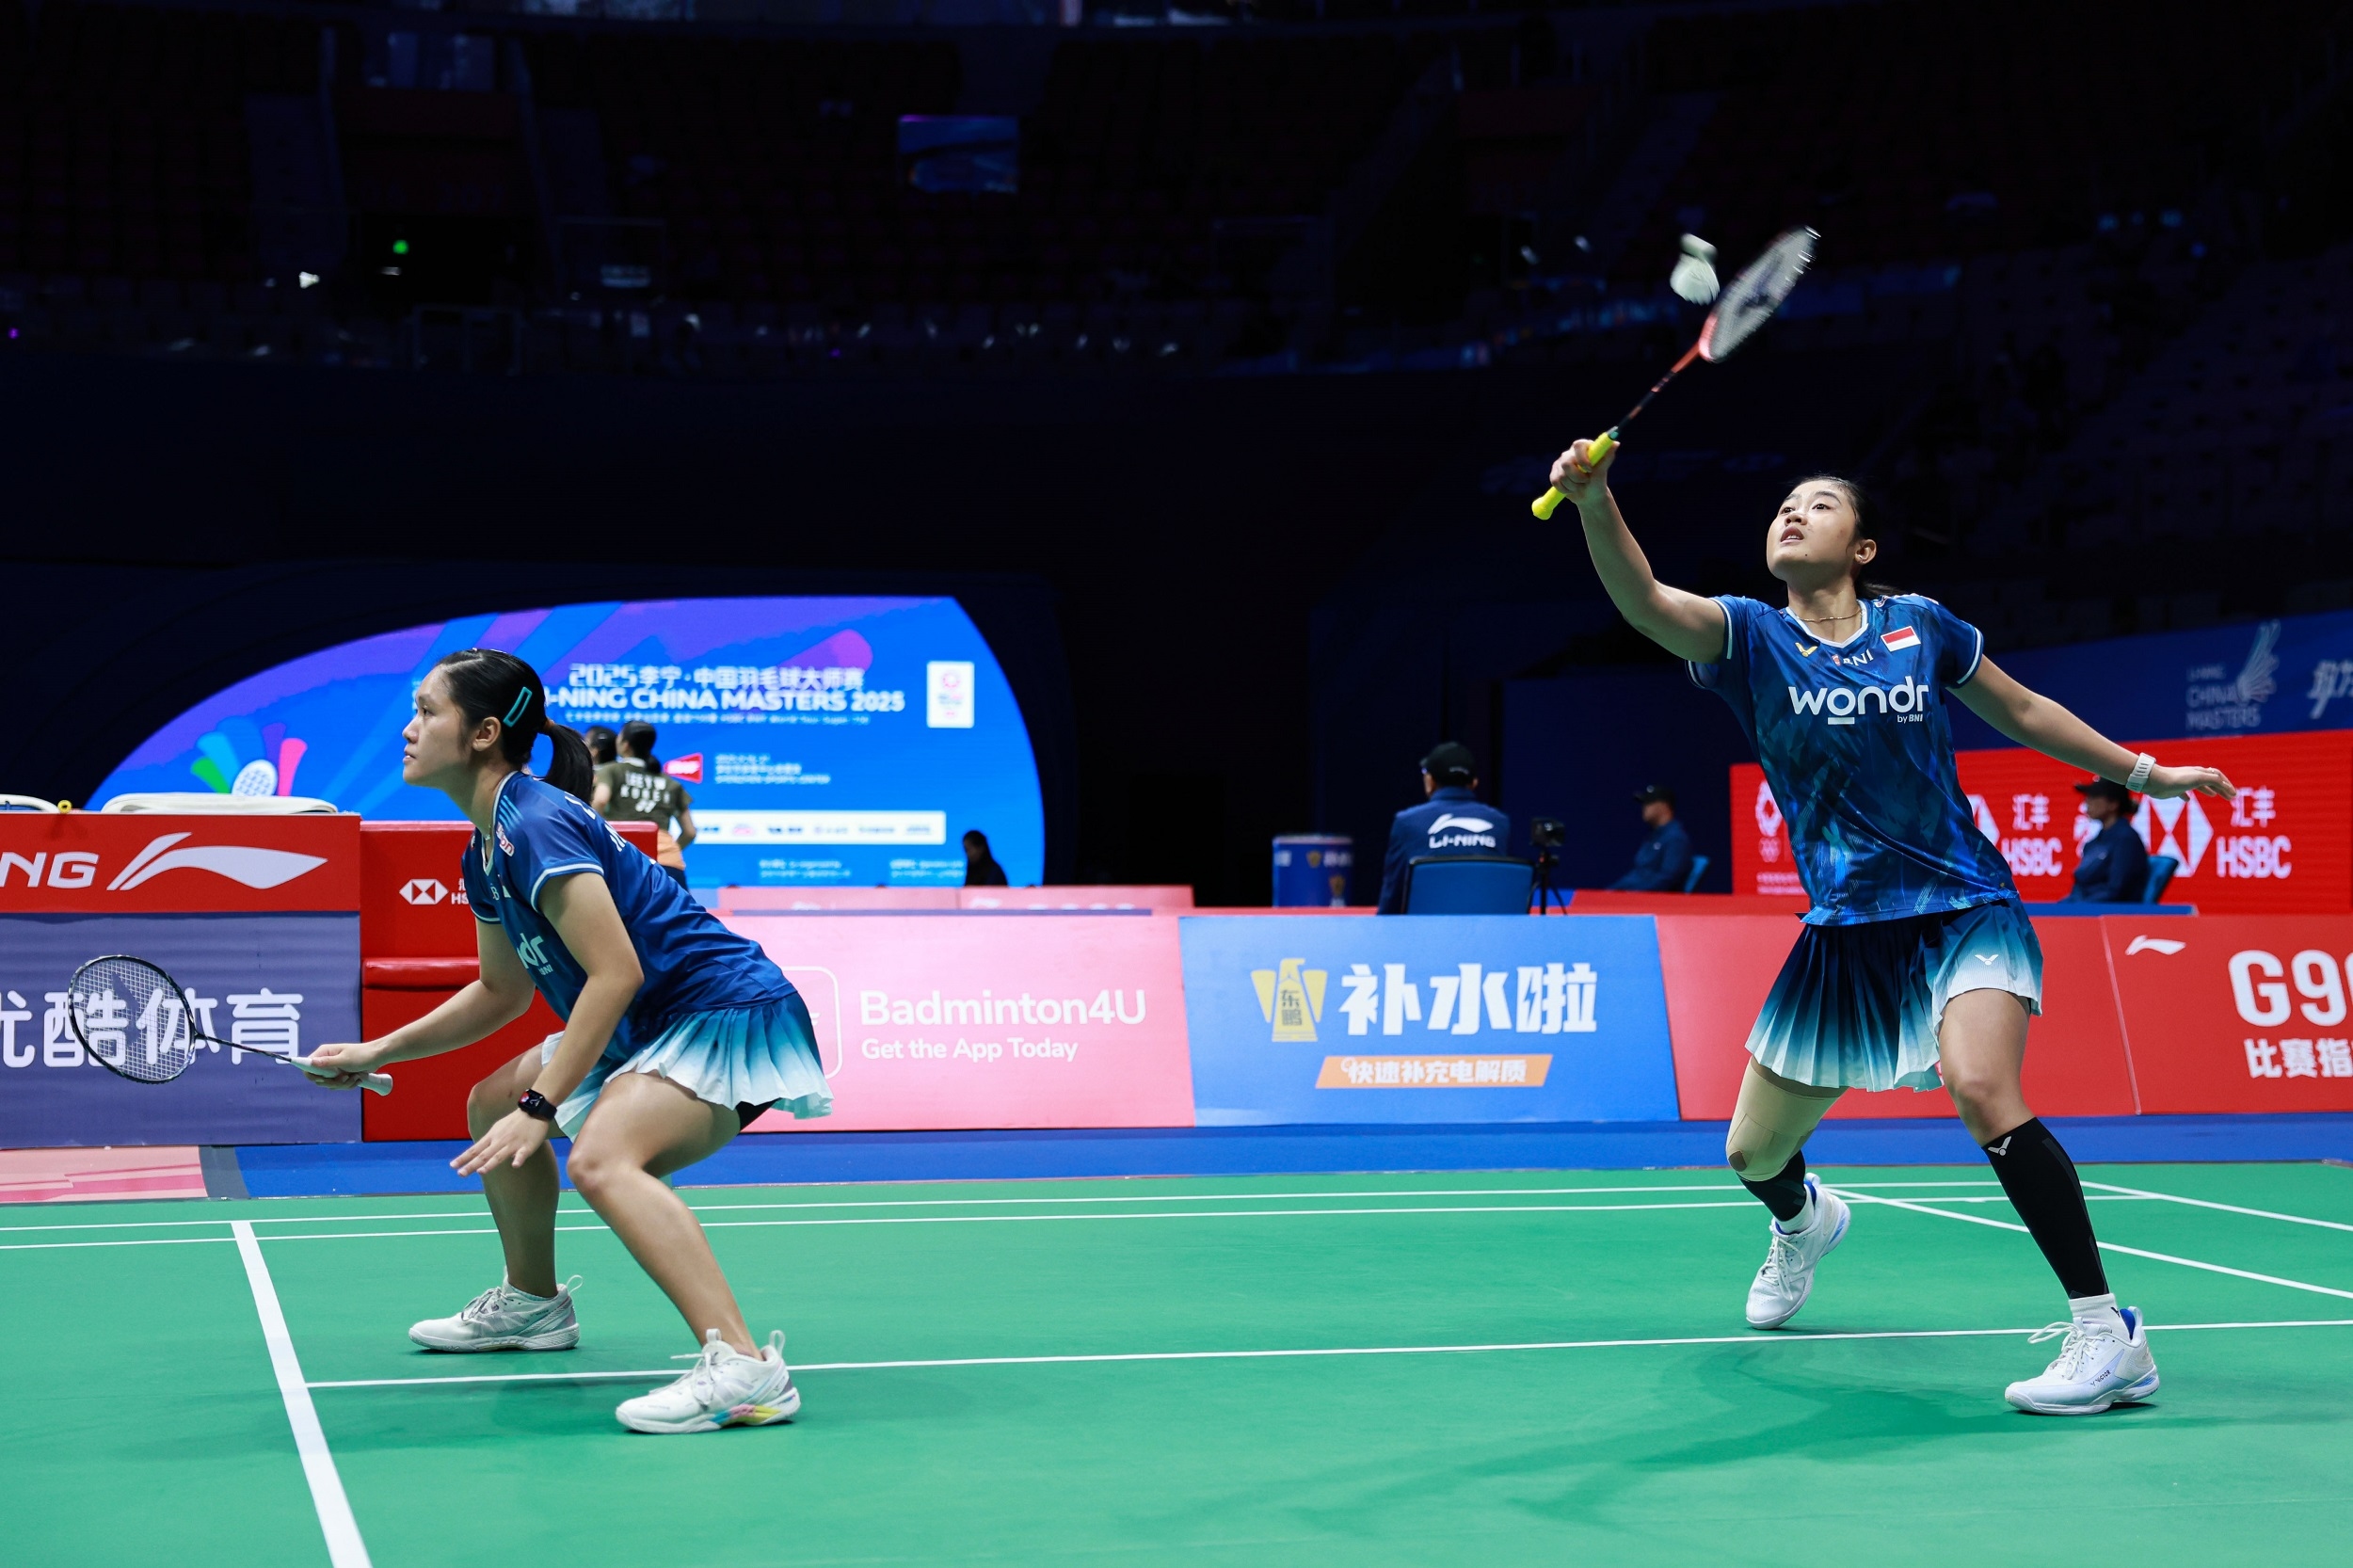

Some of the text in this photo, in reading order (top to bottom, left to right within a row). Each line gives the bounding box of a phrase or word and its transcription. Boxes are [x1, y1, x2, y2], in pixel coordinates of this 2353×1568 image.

[544, 687, 905, 713] I-NING CHINA MASTERS 2025
[1788, 676, 1929, 716] wondr
[1897, 714, 1923, 724] by BNI
[2012, 792, 2050, 831] 汇丰
[2231, 786, 2277, 828] 汇丰
[1429, 836, 1497, 849] LI-NING
[2001, 837, 2062, 878] HSBC
[2217, 836, 2292, 879] HSBC
[451, 892, 470, 905] HS
[859, 989, 1147, 1026] Badminton4U
[1338, 963, 1597, 1036] 补水啦
[2228, 949, 2353, 1028] G9
[861, 1037, 1079, 1063] Get the App Today
[2244, 1038, 2353, 1079] 比赛指
[1346, 1059, 1528, 1084] 快速补充电解质
